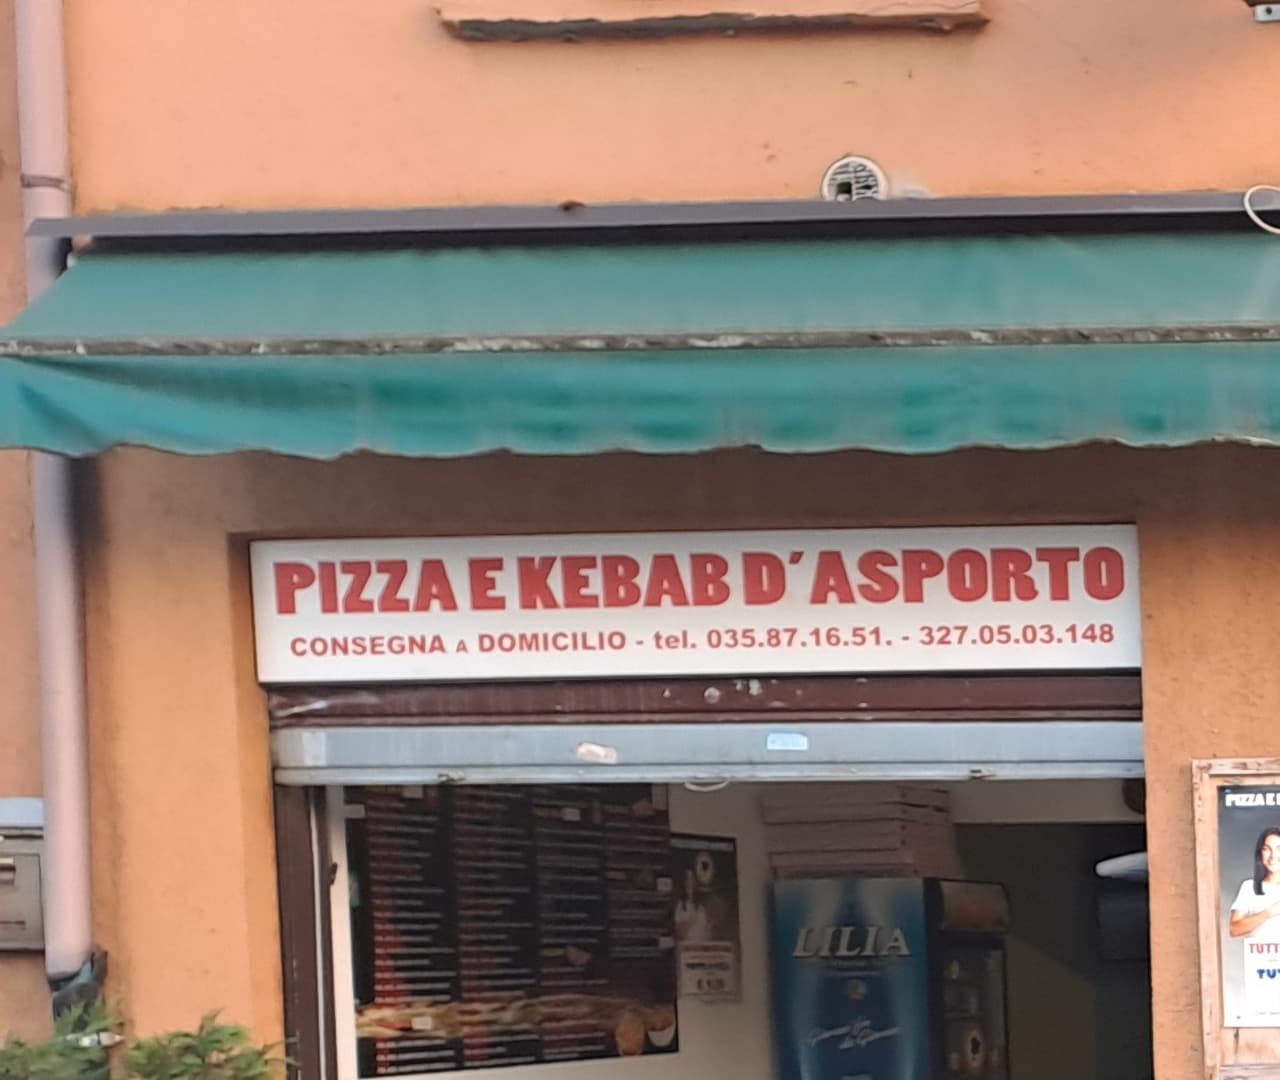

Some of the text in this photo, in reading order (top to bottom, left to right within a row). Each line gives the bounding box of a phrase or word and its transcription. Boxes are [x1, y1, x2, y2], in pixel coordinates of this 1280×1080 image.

[275, 548, 1126, 615] PIZZA E KEBAB D'ASPORTO
[290, 635, 447, 658] CONSEGNA
[456, 642, 468, 654] A
[477, 631, 628, 655] DOMICILIO
[653, 631, 698, 652] tel.
[706, 627, 894, 651] 035.87.16.51.
[918, 623, 1115, 647] 327.05.03.148
[1225, 793, 1265, 807] PIZZA
[792, 926, 912, 957] LILIA
